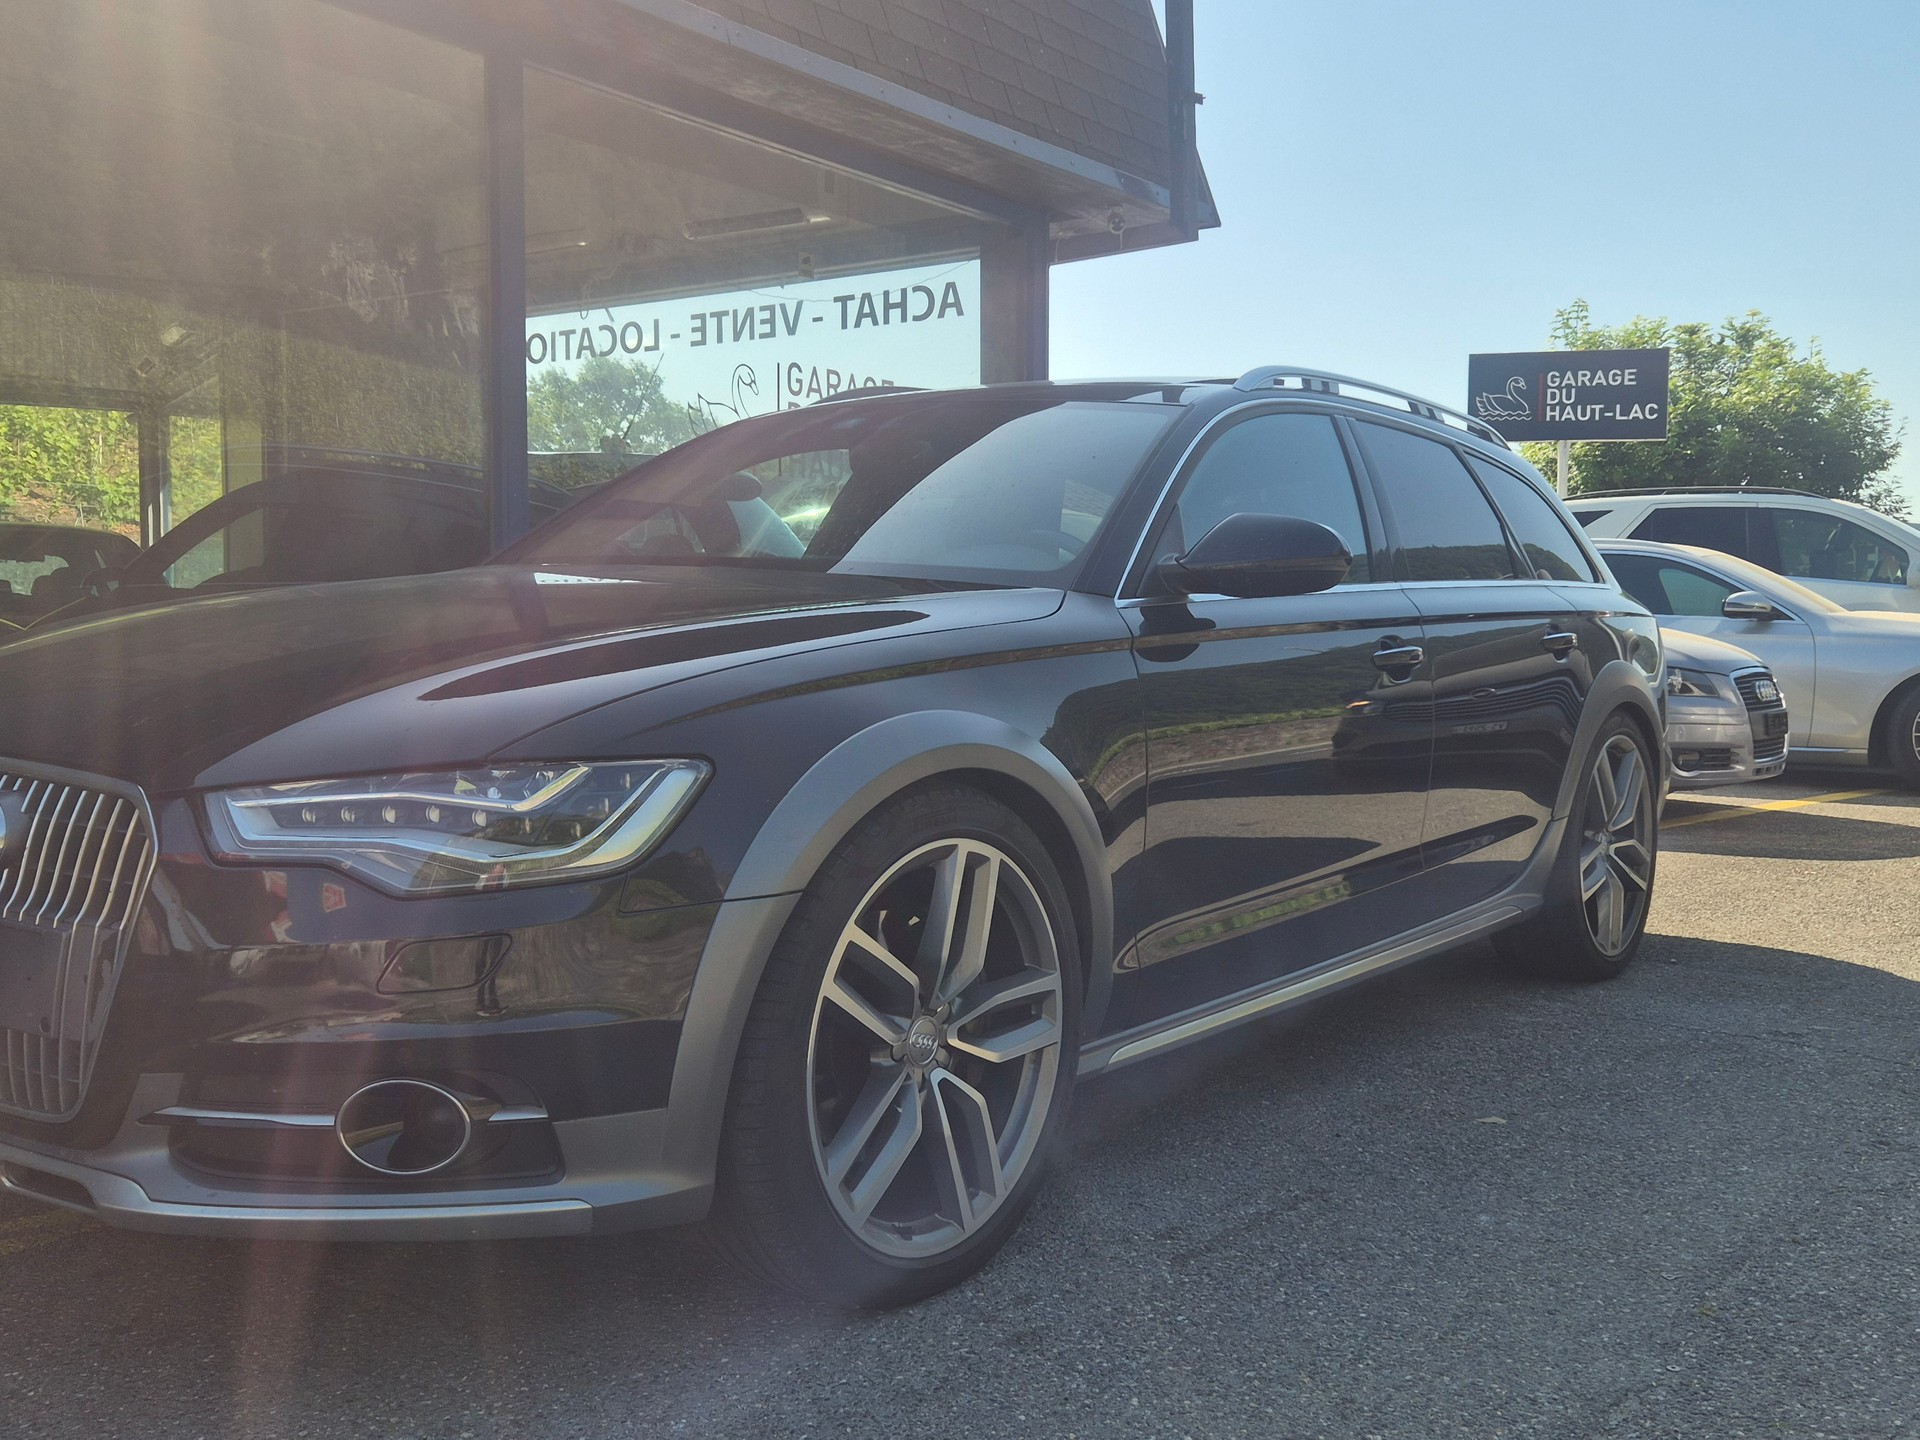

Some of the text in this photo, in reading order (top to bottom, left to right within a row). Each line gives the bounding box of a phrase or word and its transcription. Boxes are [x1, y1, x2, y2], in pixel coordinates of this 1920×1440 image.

[1547, 369, 1637, 387] GARAGE
[1547, 388, 1576, 404] DU
[1545, 403, 1659, 422] HAUT-LAC
